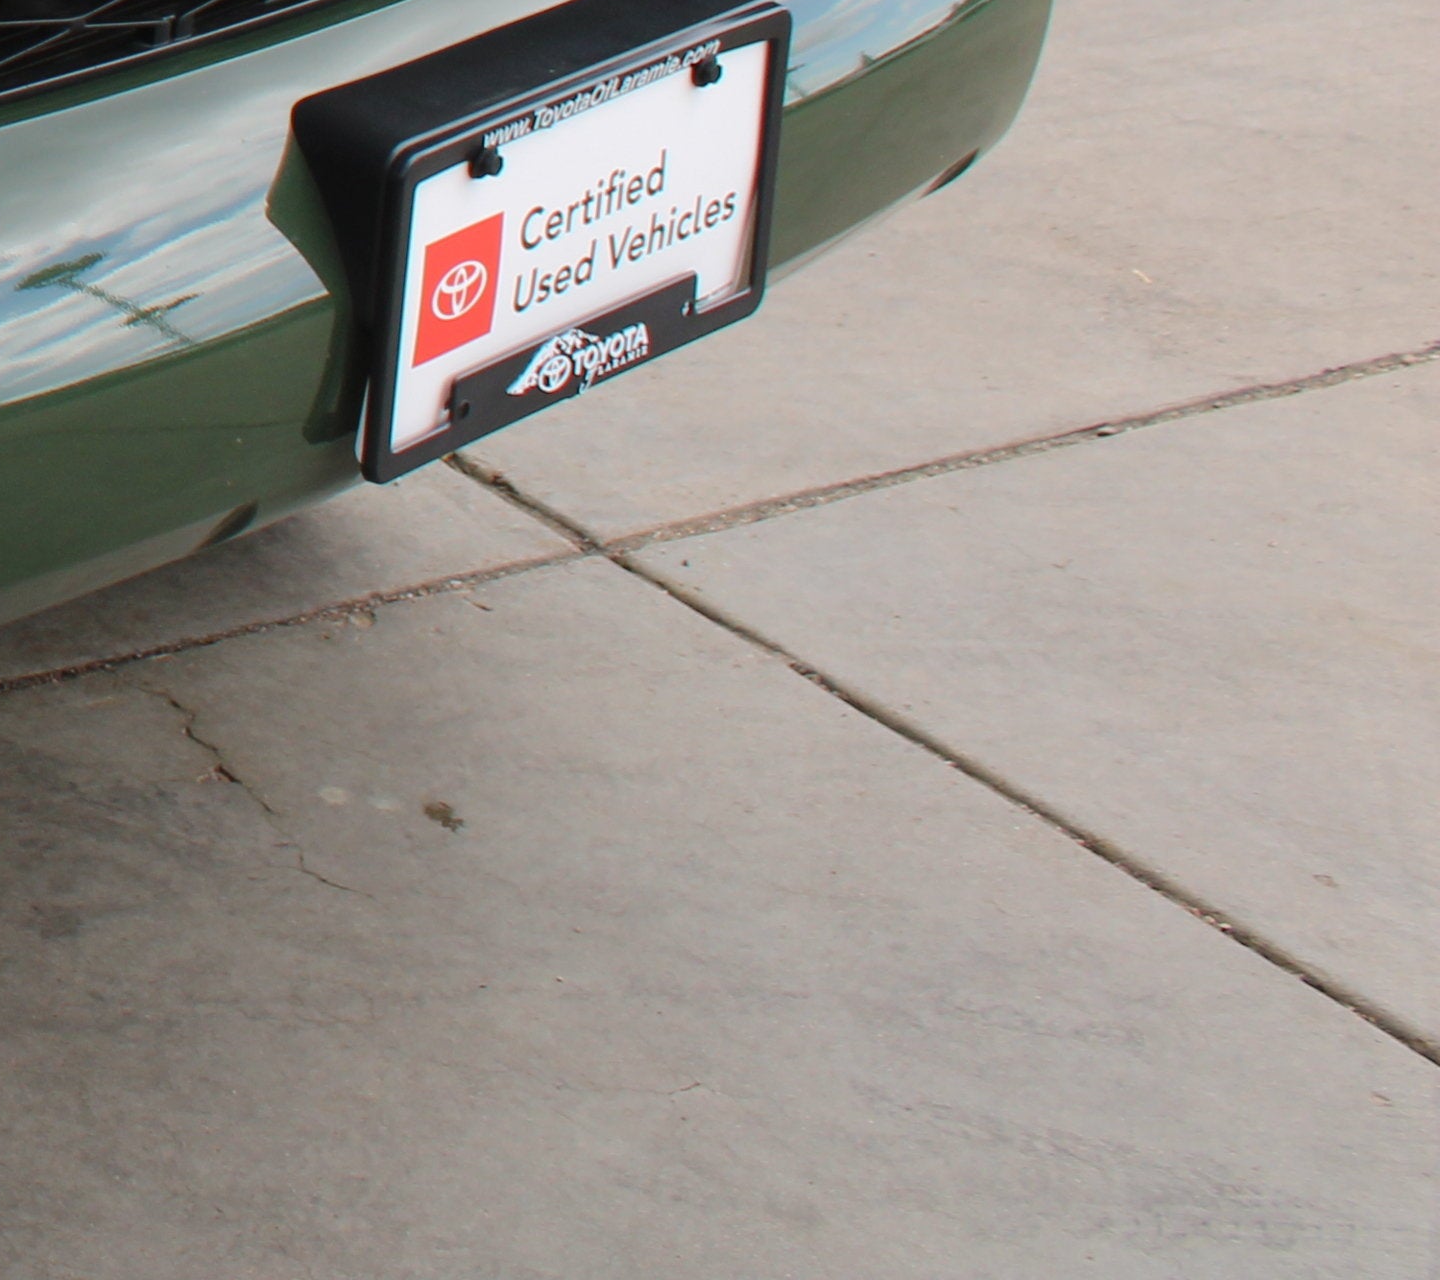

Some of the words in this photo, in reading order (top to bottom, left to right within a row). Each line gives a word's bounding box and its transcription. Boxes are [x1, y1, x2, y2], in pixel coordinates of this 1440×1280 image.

[518, 148, 668, 252] Certified
[511, 238, 597, 314] Used
[606, 191, 738, 271] Vehicles
[572, 321, 650, 377] TOYOTA
